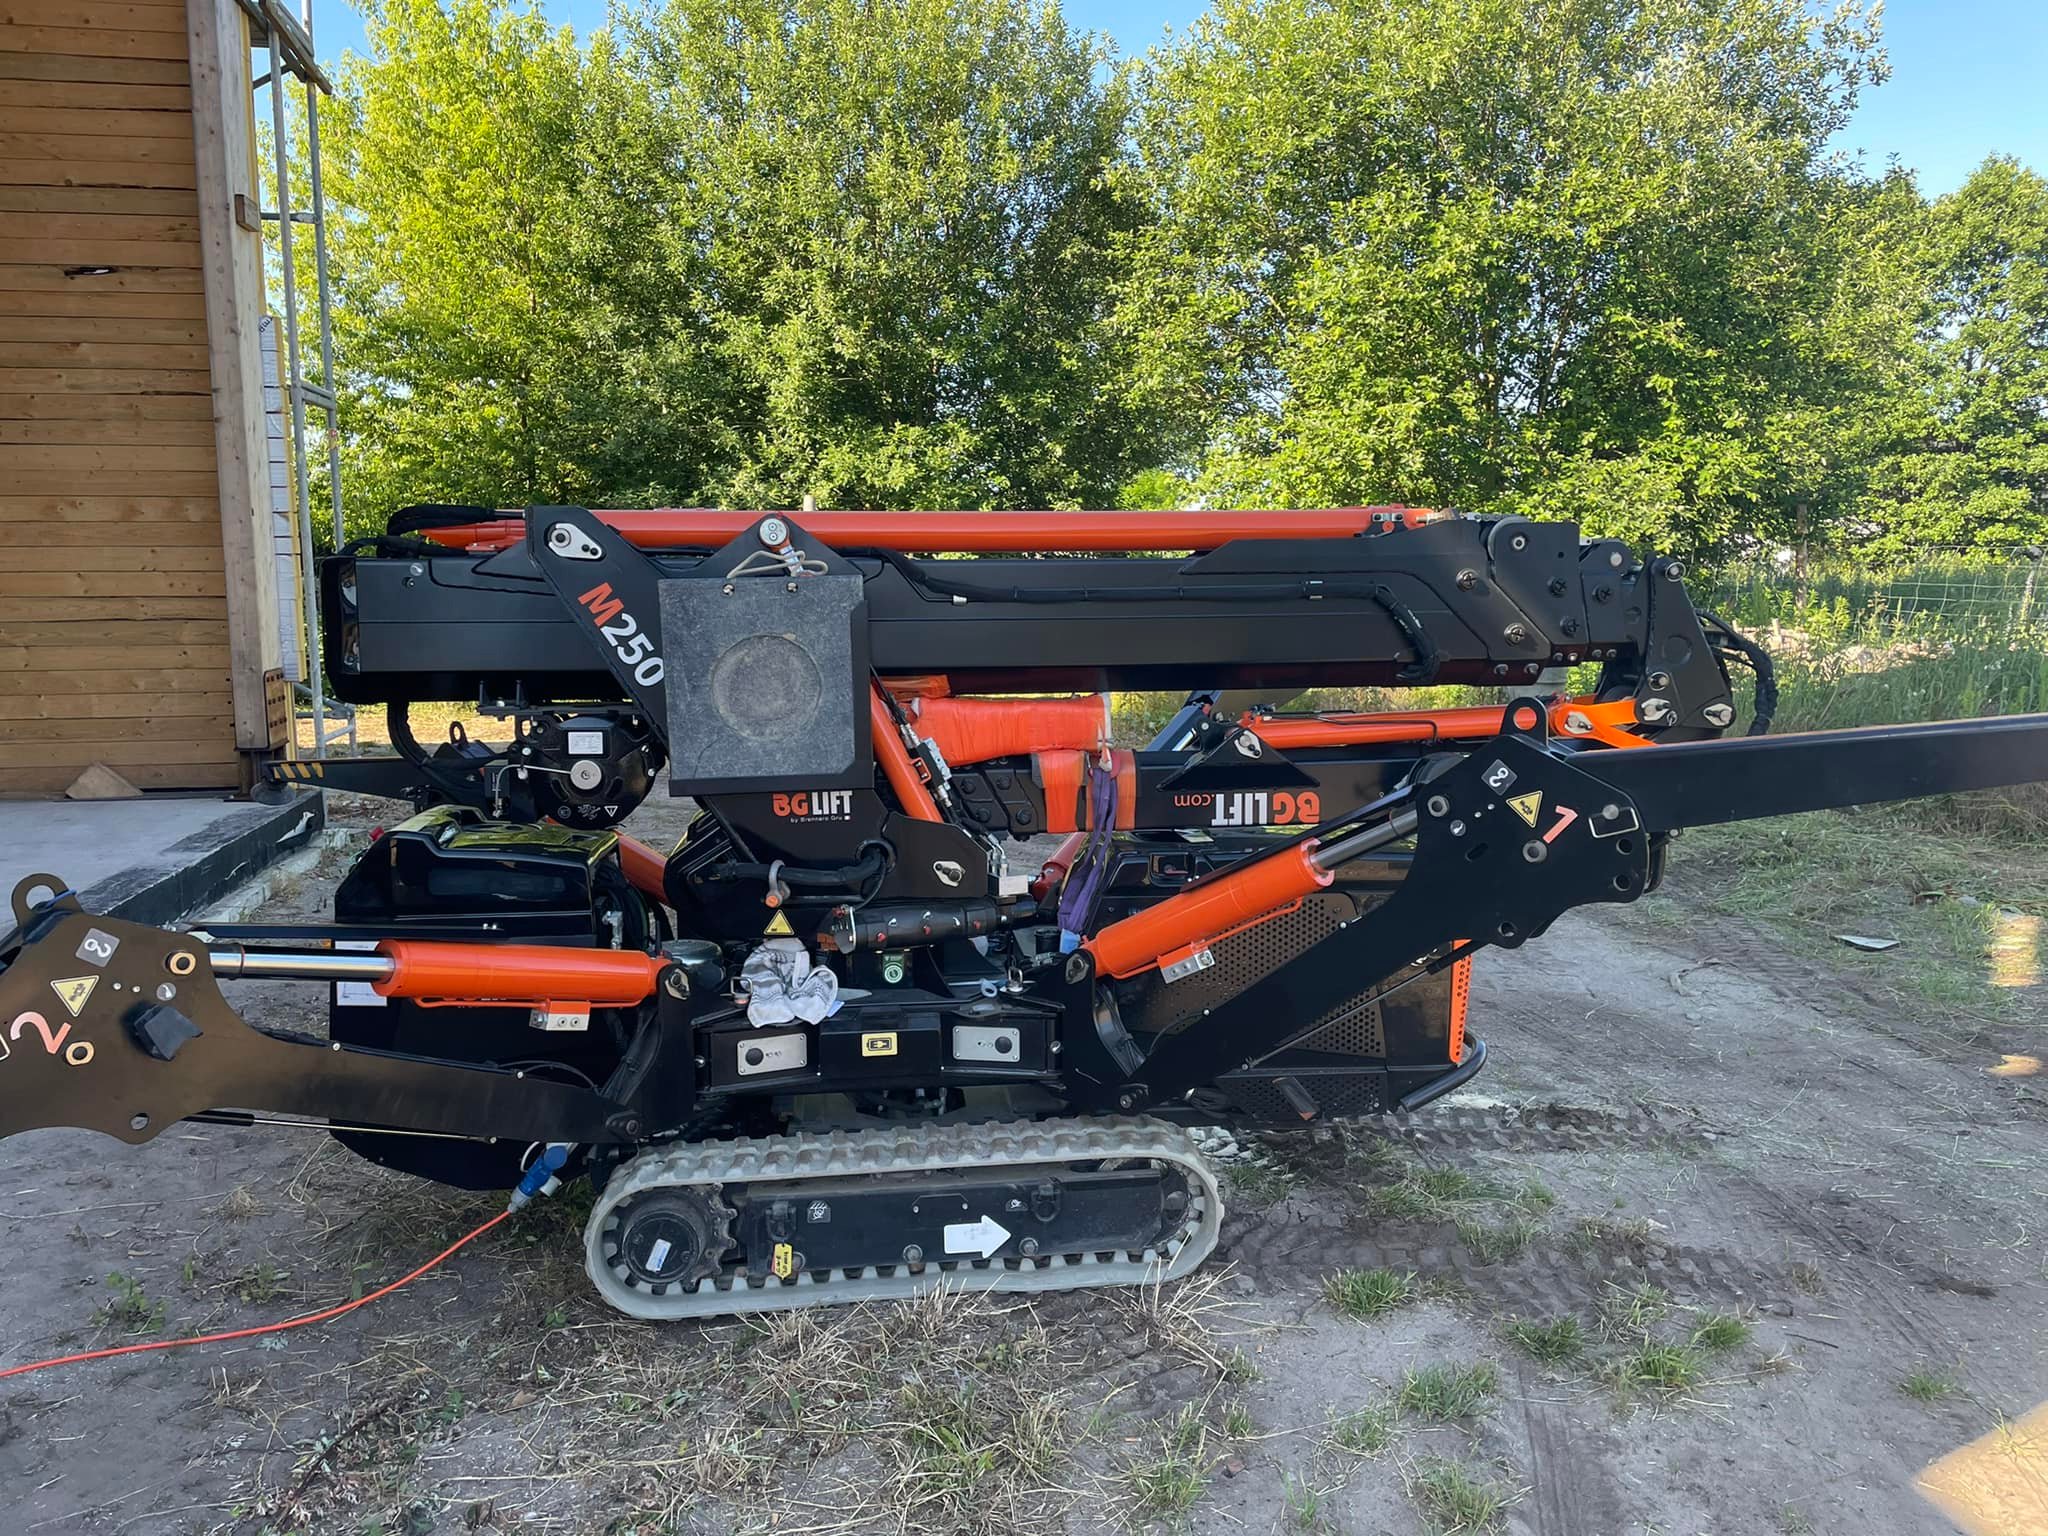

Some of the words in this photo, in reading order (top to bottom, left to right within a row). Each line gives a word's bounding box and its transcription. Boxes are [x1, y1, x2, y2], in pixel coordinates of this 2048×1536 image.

[578, 582, 665, 687] M250
[811, 790, 853, 815] LIFT
[10, 1011, 72, 1054] 2
